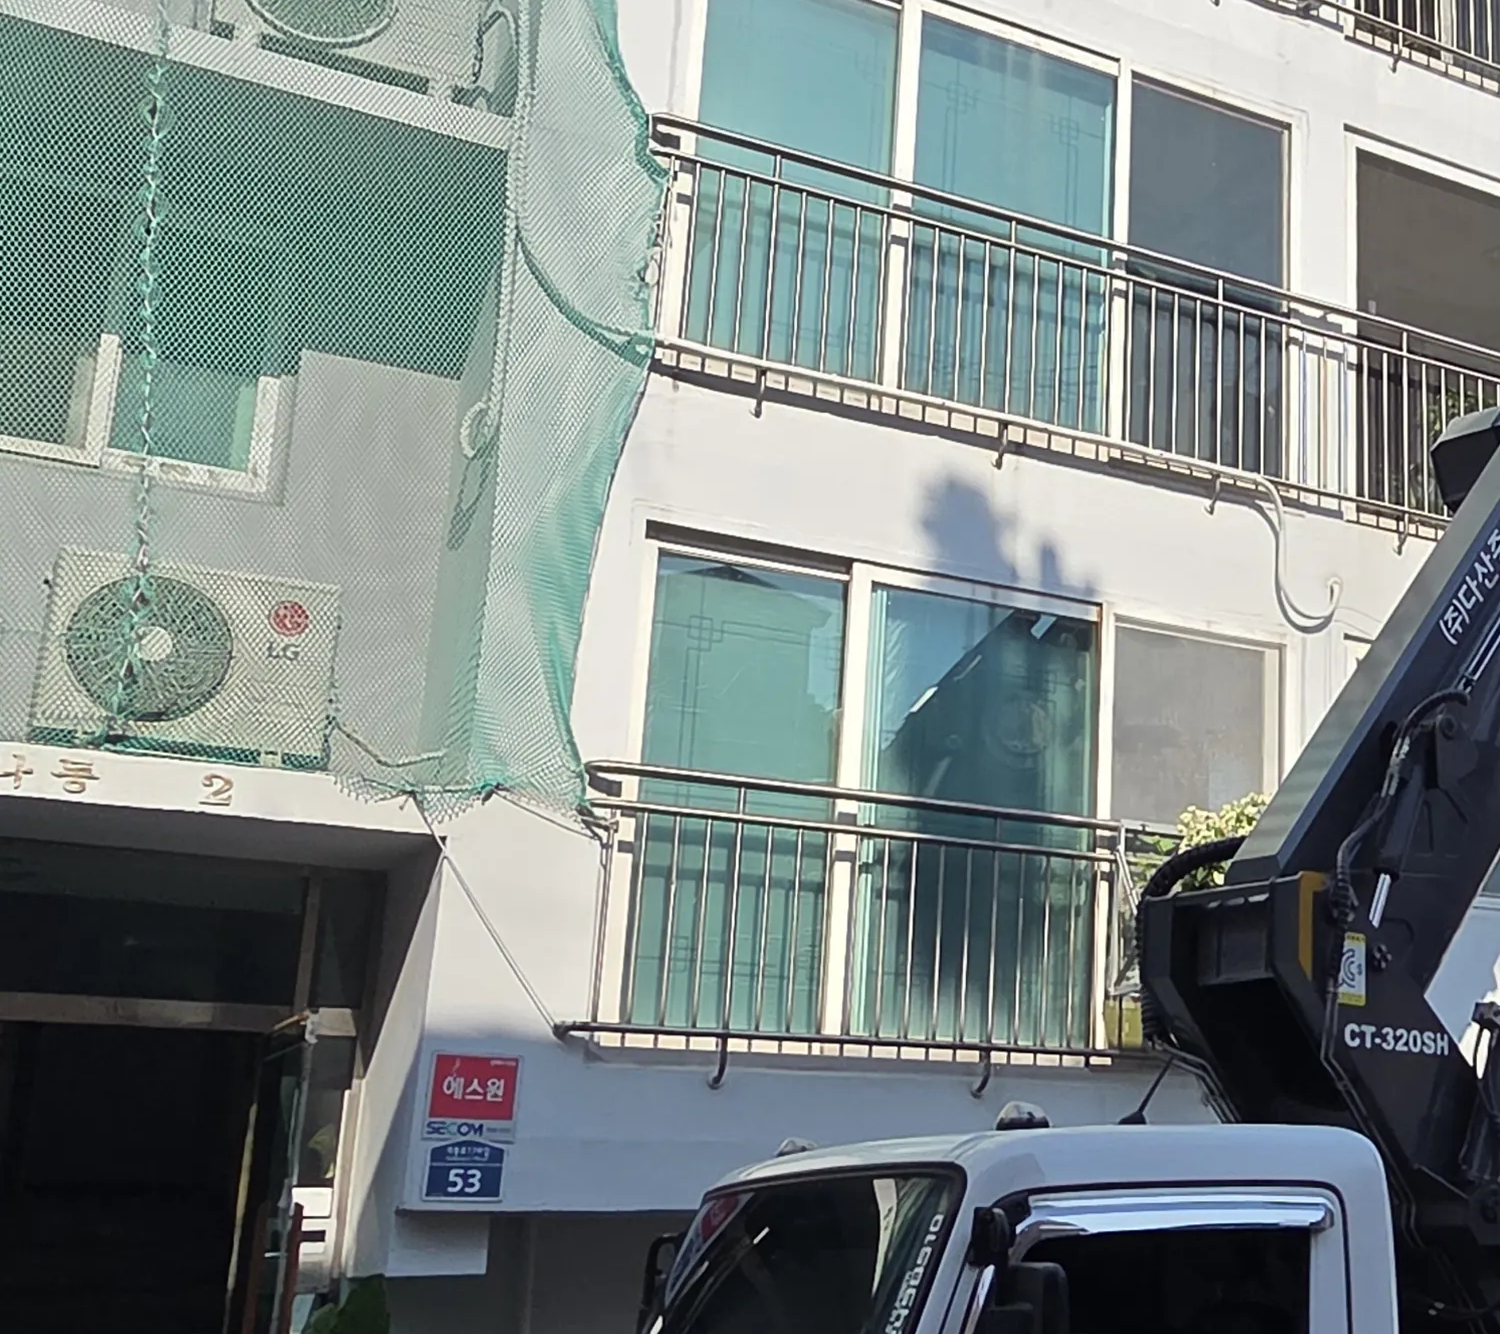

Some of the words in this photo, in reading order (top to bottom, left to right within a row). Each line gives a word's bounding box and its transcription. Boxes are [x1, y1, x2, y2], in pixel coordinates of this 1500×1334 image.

[265, 642, 300, 661] LG
[198, 773, 234, 807] 2
[1343, 1022, 1450, 1057] CT-320SH
[442, 1075, 505, 1102] 에스원
[425, 1120, 485, 1137] SECOM
[446, 1168, 482, 1194] 53
